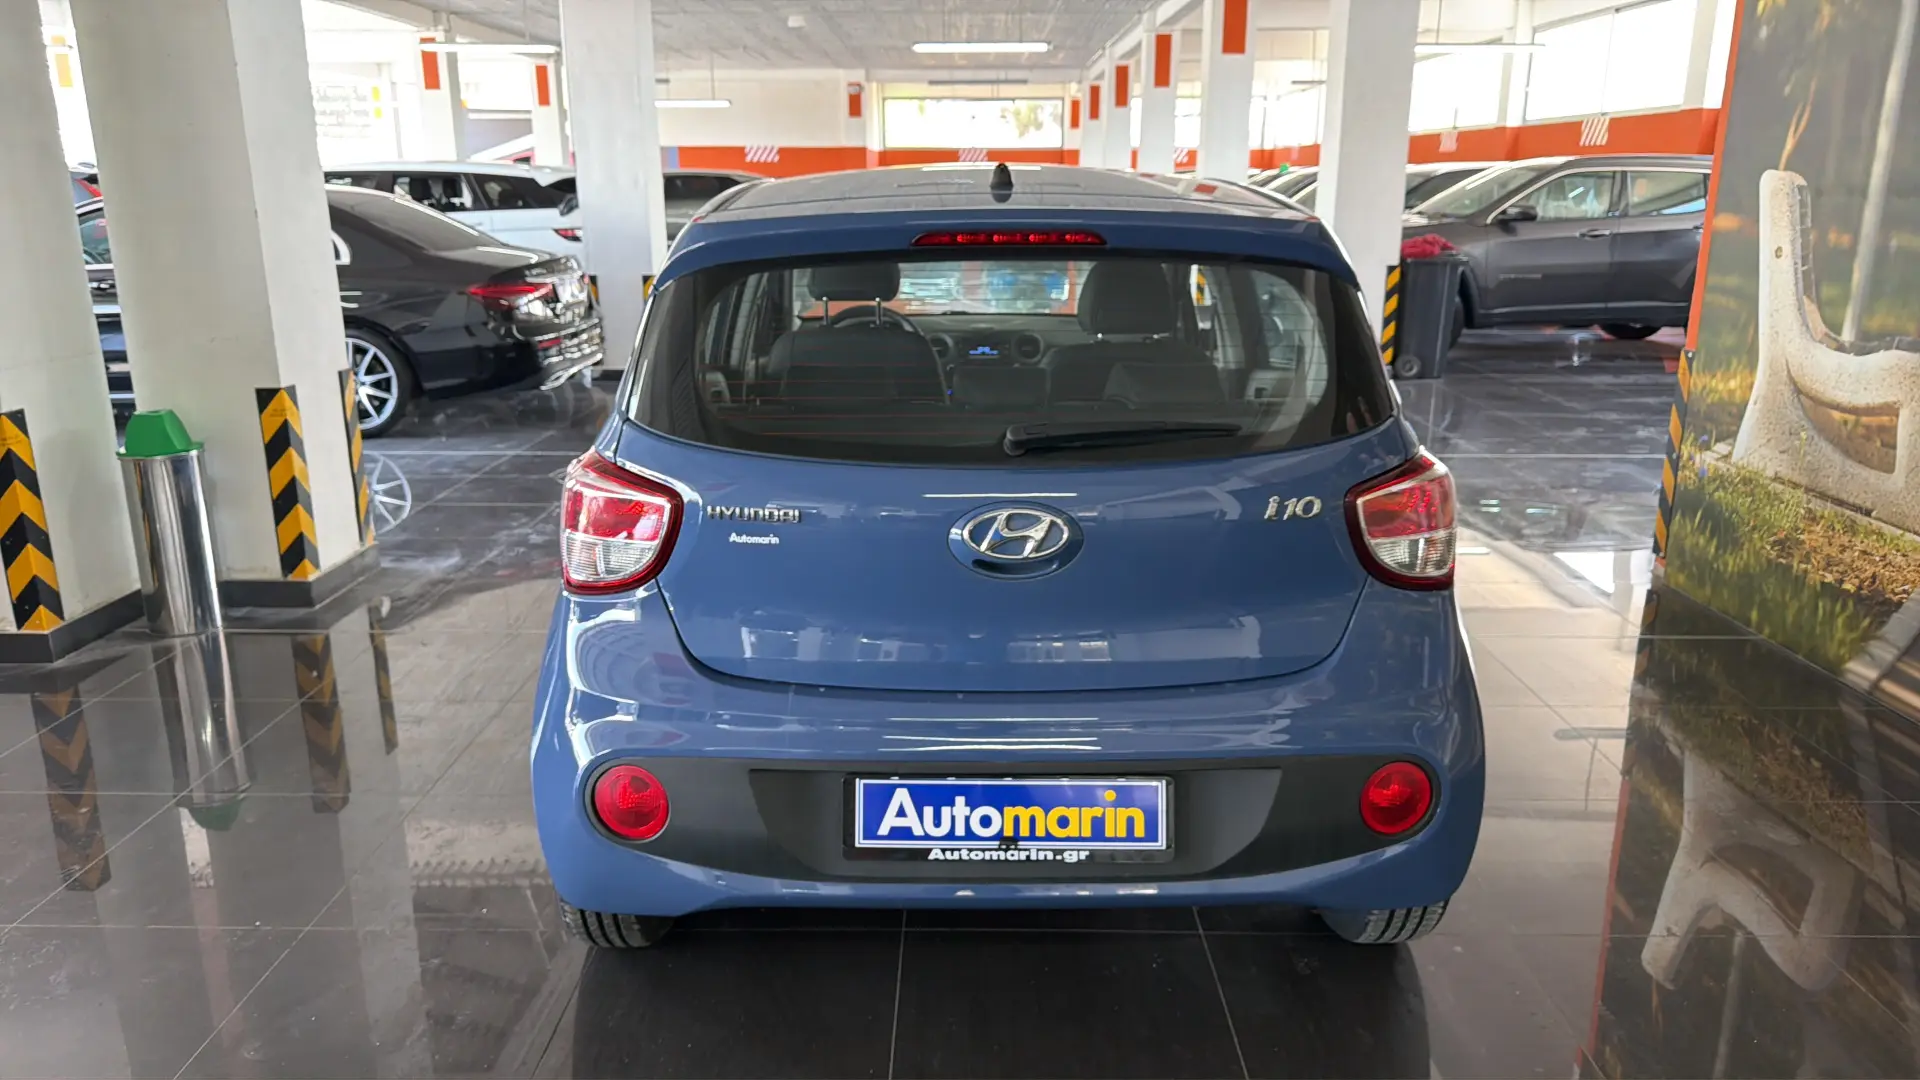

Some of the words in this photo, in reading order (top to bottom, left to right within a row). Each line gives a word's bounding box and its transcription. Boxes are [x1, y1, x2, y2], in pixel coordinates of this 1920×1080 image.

[707, 505, 801, 523] HYUNDAI
[1264, 496, 1322, 520] i10
[729, 532, 780, 545] Automarin
[877, 788, 1145, 837] Automarin
[928, 848, 1089, 863] Automarin.gr
